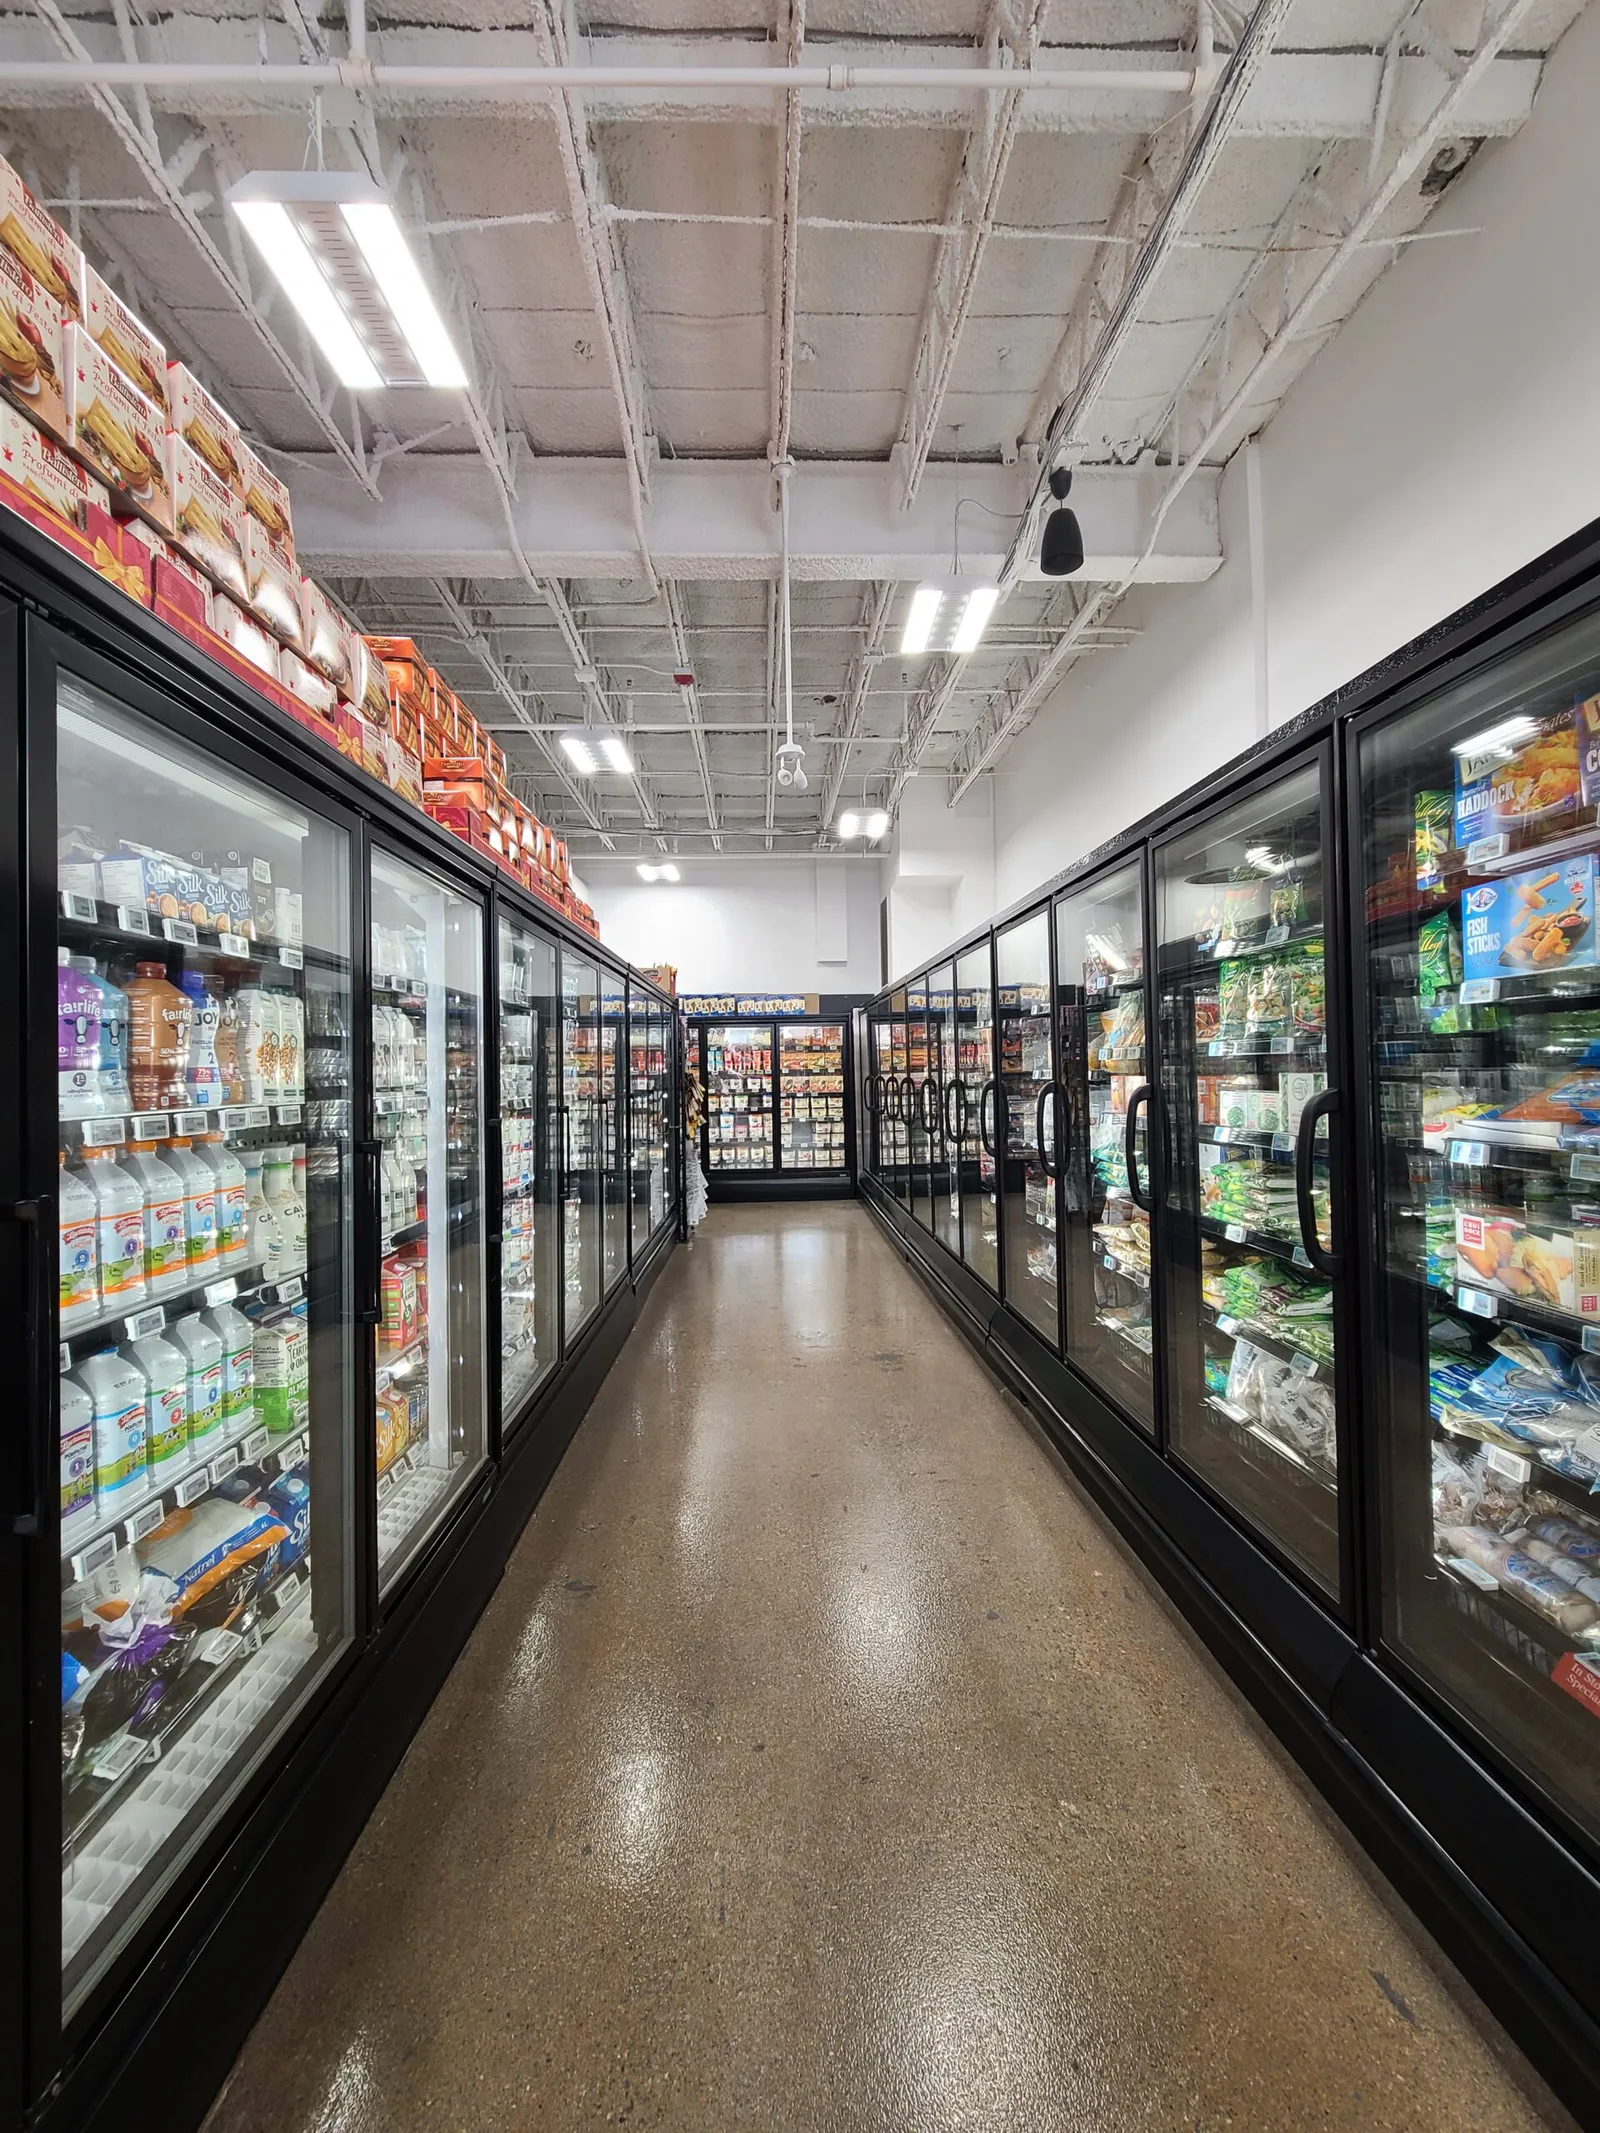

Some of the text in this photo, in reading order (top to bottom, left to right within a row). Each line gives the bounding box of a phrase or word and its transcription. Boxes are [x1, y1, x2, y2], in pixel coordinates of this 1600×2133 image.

[92, 371, 131, 414] Profumi
[21, 448, 67, 491] Profumi
[1457, 781, 1514, 819] HADDOCK
[146, 861, 176, 886] Silk
[177, 873, 205, 894] Silk
[204, 883, 231, 907] Silk
[230, 891, 253, 913] Silk
[1467, 917, 1489, 937] FISH
[1467, 932, 1501, 956] STICKS
[79, 1254, 86, 1263] 2
[1576, 1452, 1588, 1465] 750
[290, 1510, 310, 1545] Sil
[182, 1554, 217, 1585] Natrel
[1571, 1663, 1584, 1677] In
